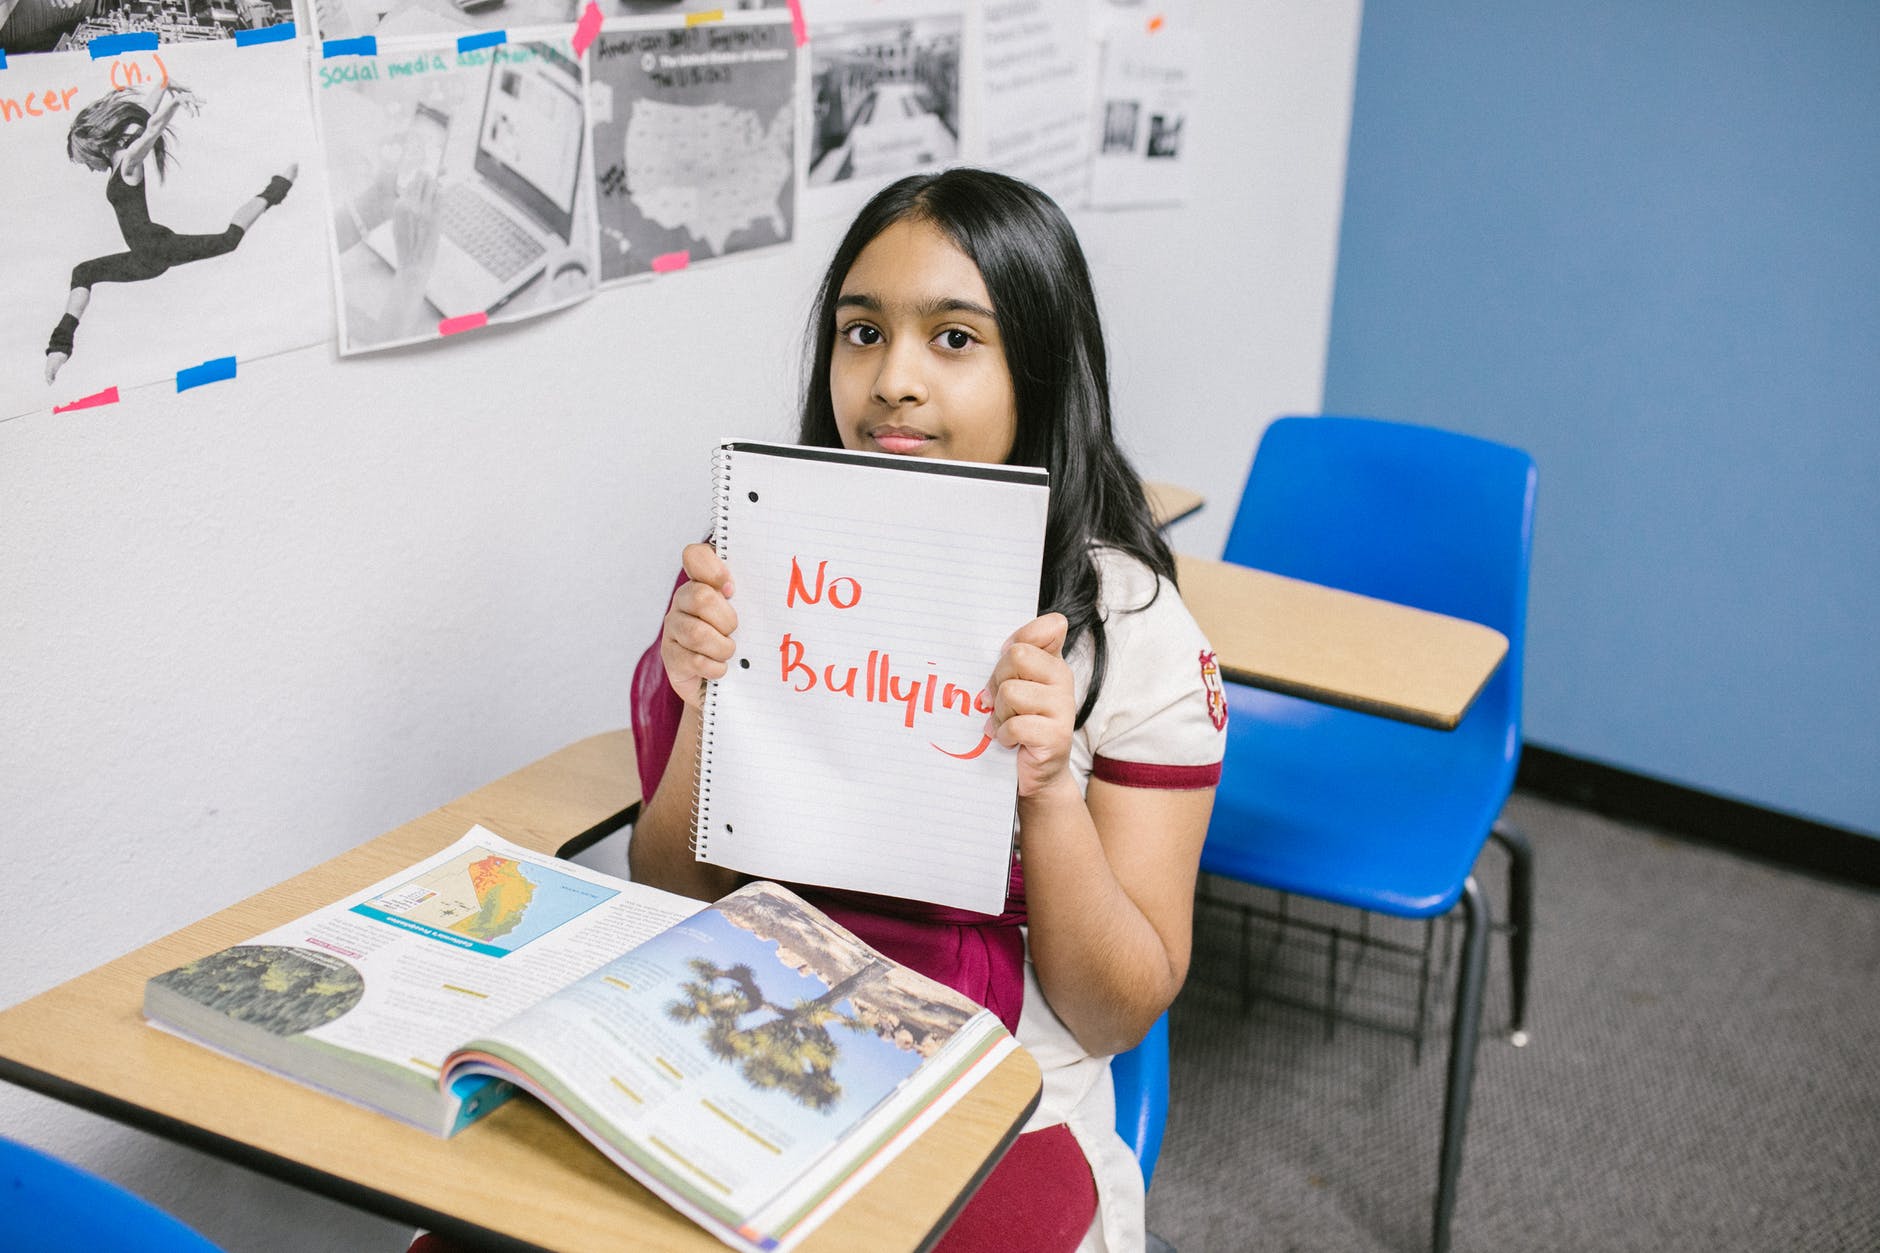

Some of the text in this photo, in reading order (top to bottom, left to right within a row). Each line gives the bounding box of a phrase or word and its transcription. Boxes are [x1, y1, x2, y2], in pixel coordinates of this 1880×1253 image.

[110, 54, 169, 91] (n.)
[319, 60, 379, 88] social
[387, 54, 447, 80] media
[786, 556, 862, 609] No
